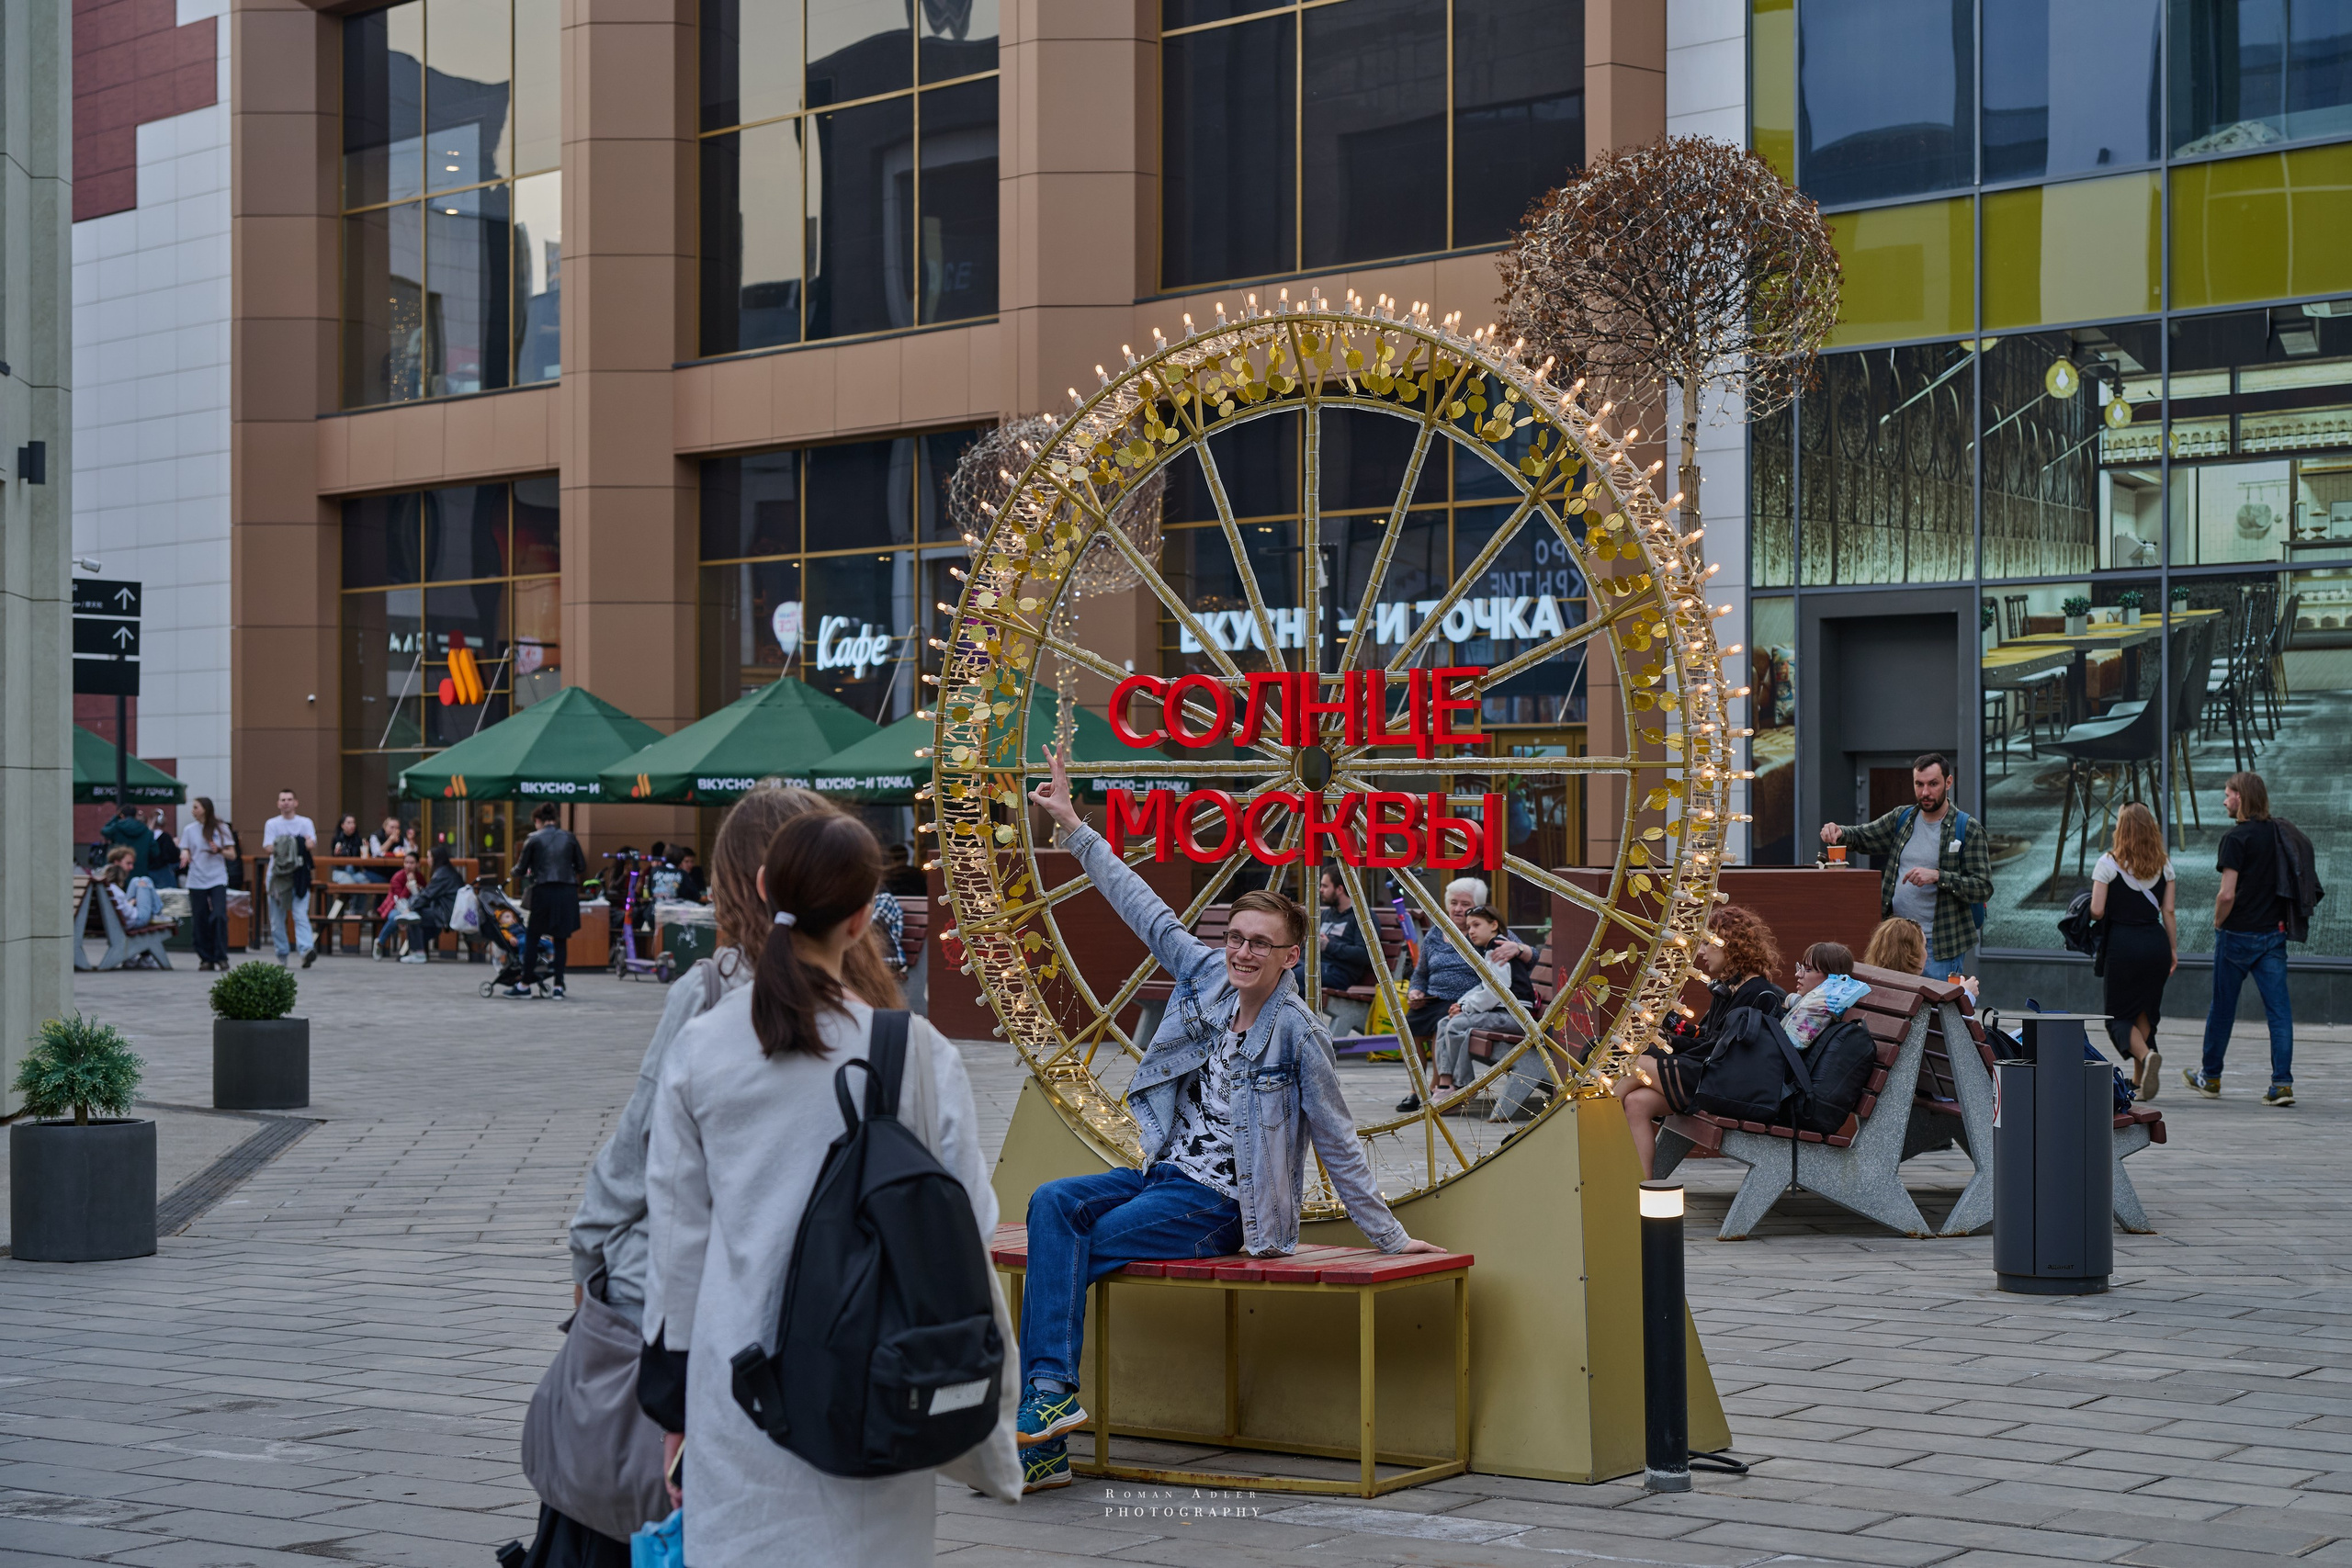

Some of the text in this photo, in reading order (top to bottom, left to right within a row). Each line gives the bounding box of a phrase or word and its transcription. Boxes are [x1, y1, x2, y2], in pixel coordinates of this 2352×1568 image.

[817, 615, 892, 680] Кафе
[1109, 667, 1492, 760] СОЛНЦЕ
[876, 776, 914, 789] ТОЧКА
[1155, 780, 1191, 792] ТОЧКА
[1106, 789, 1503, 871] МОСКВЫ
